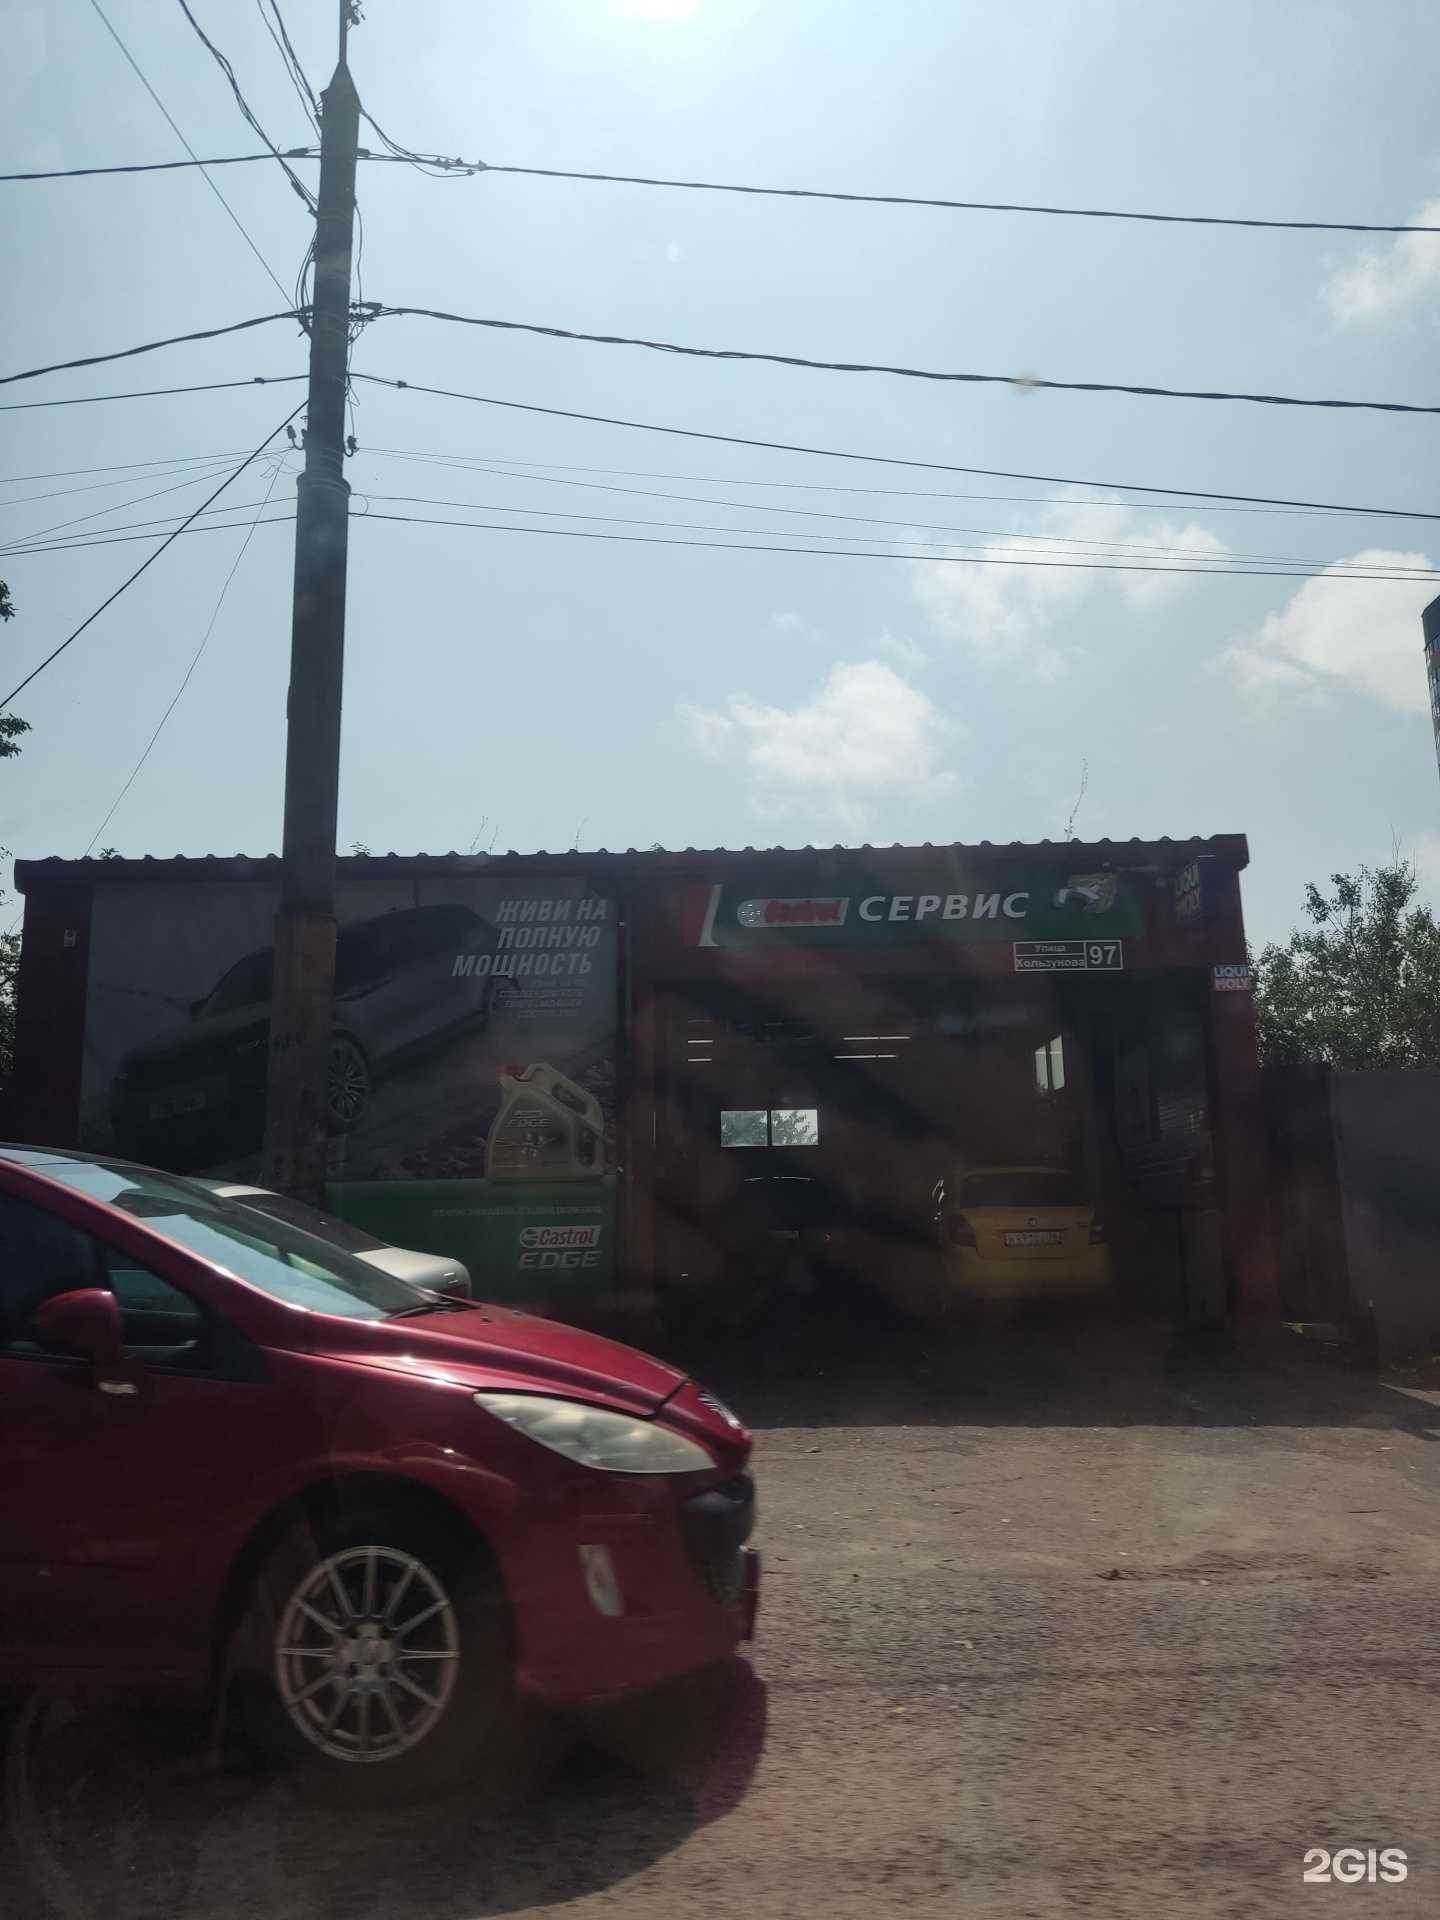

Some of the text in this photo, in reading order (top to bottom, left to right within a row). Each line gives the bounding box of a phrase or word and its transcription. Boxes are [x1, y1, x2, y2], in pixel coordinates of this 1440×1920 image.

[497, 898, 607, 921] ЖИВИ НА
[858, 892, 1029, 921] СЕРВИС
[498, 926, 601, 949] ПОЛНУЮ
[1016, 957, 1085, 969] Хользунова
[1089, 945, 1117, 965] 97
[452, 954, 592, 978] МОЩНОСТЬ
[540, 1228, 594, 1246] Castrol
[520, 1250, 600, 1269] EDGE
